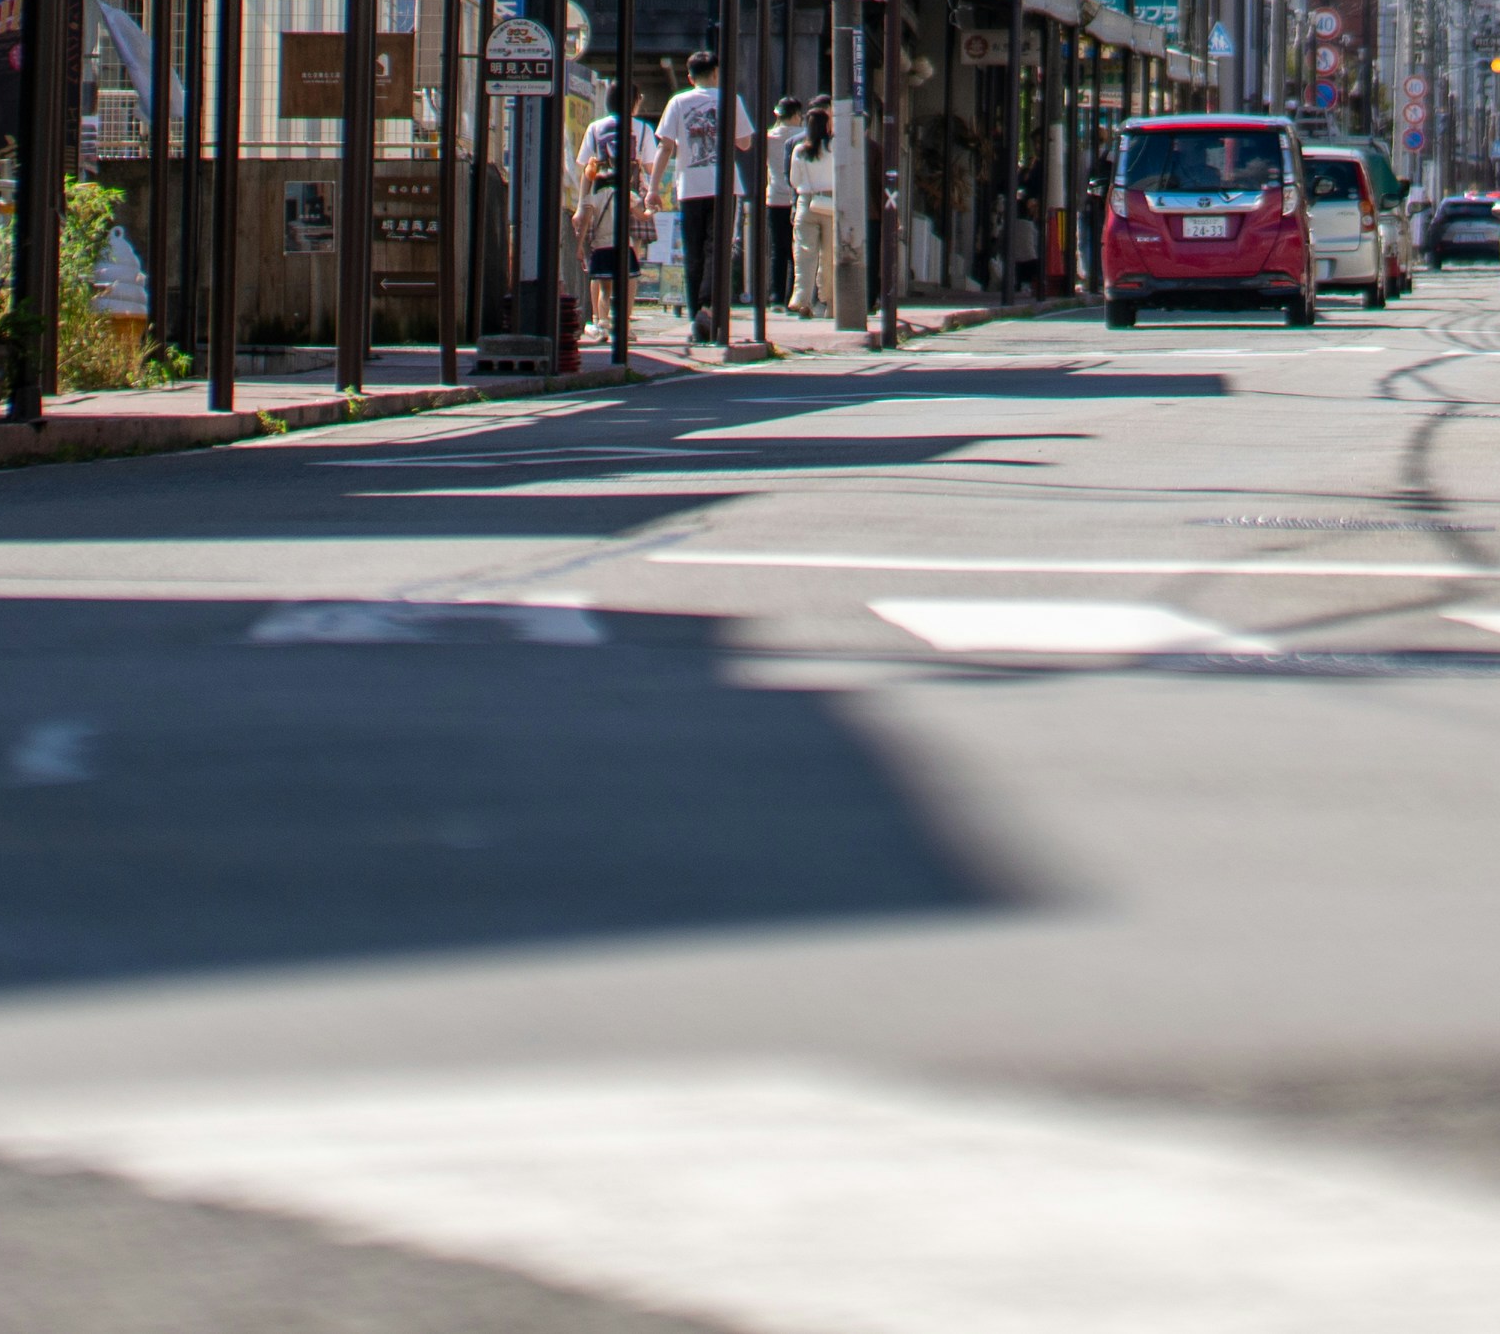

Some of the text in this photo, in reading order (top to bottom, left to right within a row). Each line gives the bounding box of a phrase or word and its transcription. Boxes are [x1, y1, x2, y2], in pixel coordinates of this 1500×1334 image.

[1317, 17, 1333, 29] 40
[490, 62, 547, 74] 明見入口
[856, 86, 864, 96] 2
[1409, 83, 1421, 92] 40
